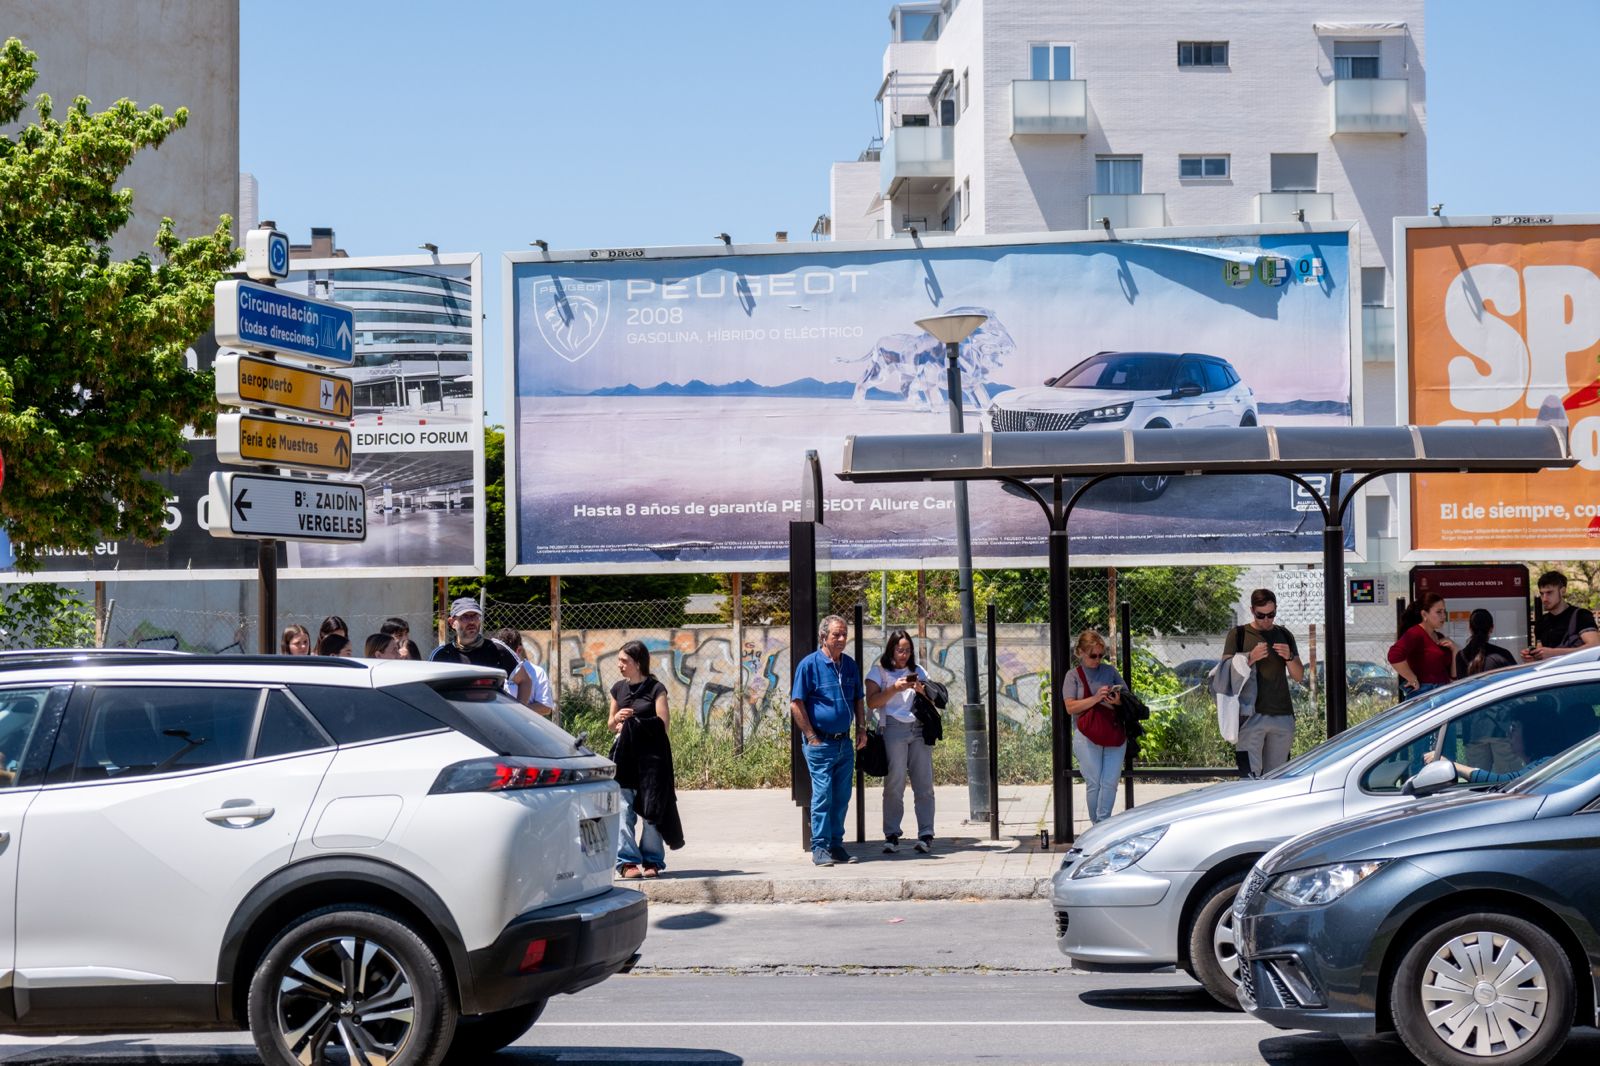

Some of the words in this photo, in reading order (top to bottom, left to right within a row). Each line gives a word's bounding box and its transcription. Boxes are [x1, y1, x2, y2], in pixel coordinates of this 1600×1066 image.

[540, 284, 603, 294] PEUGEOT
[627, 270, 870, 300] PEUGEOT
[240, 291, 319, 325] Circunvalación
[626, 307, 684, 325] 2008
[240, 316, 268, 337] (todas
[270, 325, 319, 349] direcciones)
[627, 330, 703, 345] GASOLINA,
[708, 327, 765, 342] HÍBRIDO
[769, 329, 780, 340] O
[784, 325, 864, 340] ELÉCTRICO
[241, 371, 293, 394] aeropuerto
[242, 430, 263, 448] Feria
[266, 433, 277, 449] de
[279, 435, 318, 454] Muestras
[357, 432, 415, 446] EDIFICIO
[420, 431, 468, 444] FORUM
[573, 504, 622, 517] Hasta
[625, 504, 636, 516] 8
[640, 503, 680, 515] años
[684, 502, 705, 514] de
[709, 501, 777, 517] garantía
[782, 498, 866, 512] PEGEOT
[870, 498, 919, 510] Allure
[923, 497, 955, 510] Car
[1440, 502, 1457, 520] El
[1461, 502, 1485, 519] de
[1489, 502, 1570, 522] siempre,
[298, 514, 363, 533] VERGELES
